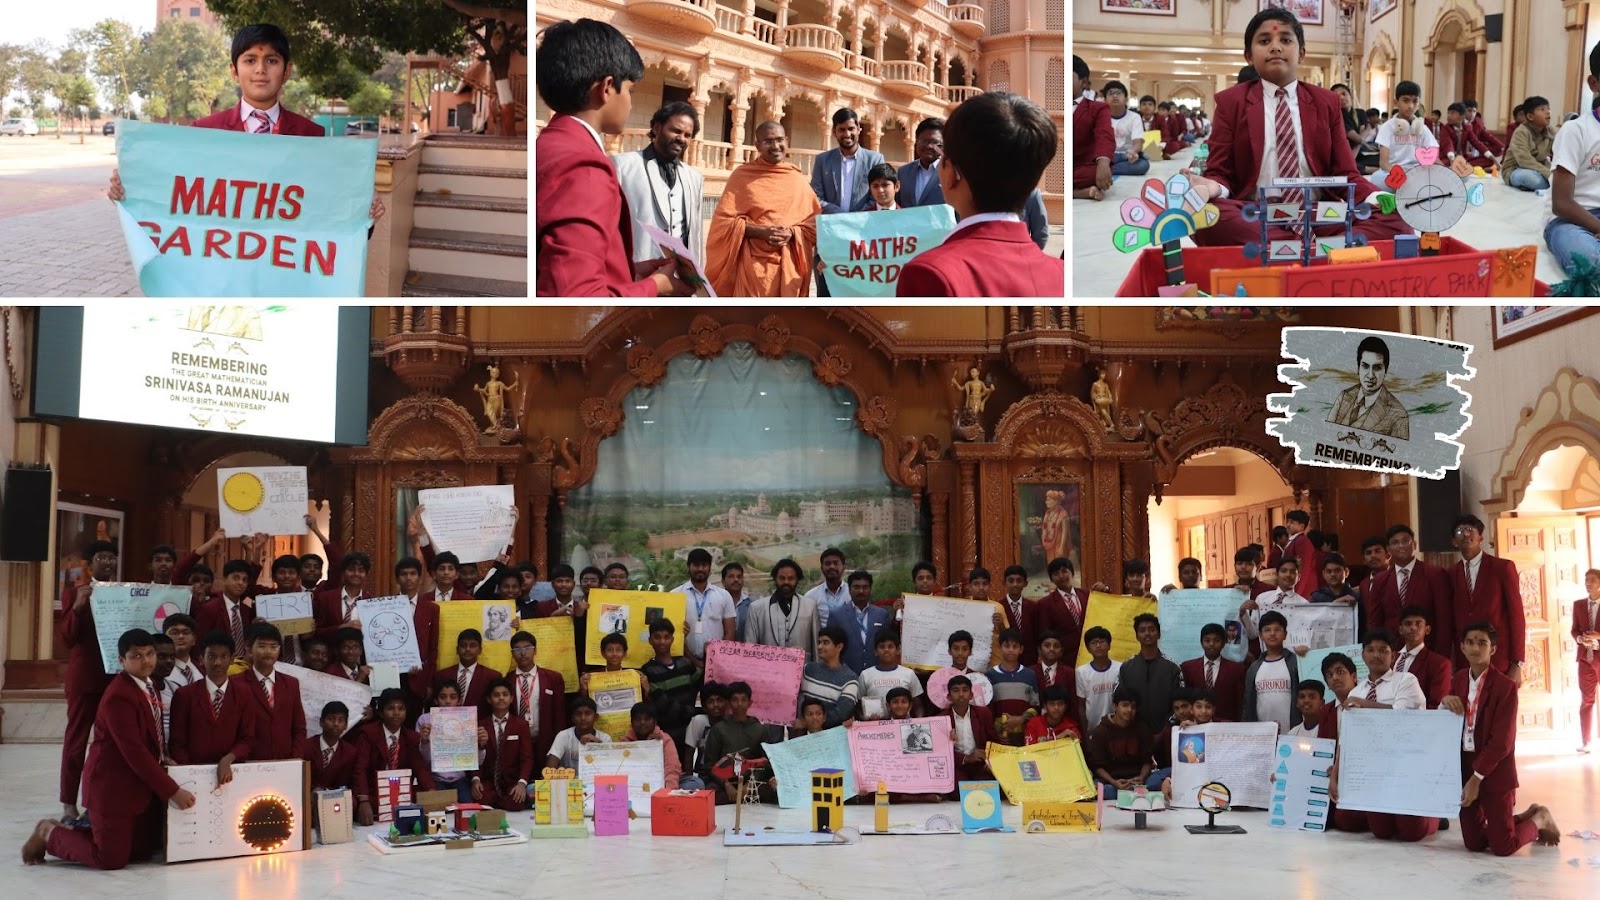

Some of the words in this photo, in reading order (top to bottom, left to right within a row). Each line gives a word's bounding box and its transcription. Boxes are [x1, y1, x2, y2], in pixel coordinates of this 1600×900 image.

[170, 175, 305, 220] MATHS
[137, 221, 337, 276] GARDEN
[849, 236, 918, 261] MATHS
[832, 264, 901, 283] GARD
[1447, 272, 1486, 294] PARK
[171, 351, 268, 376] REMEMBERING
[172, 368, 186, 377] THE
[187, 370, 209, 380] GREAT
[211, 373, 267, 386] MATHEMATICIAN
[145, 375, 212, 395] SRINIVASA
[216, 384, 290, 403] RAMANUJAN
[170, 394, 180, 402] ON
[182, 396, 195, 404] HIS
[196, 397, 217, 406] BIRTH
[219, 401, 266, 411] ANNIVERSARY
[130, 587, 150, 597] CIRCLE
